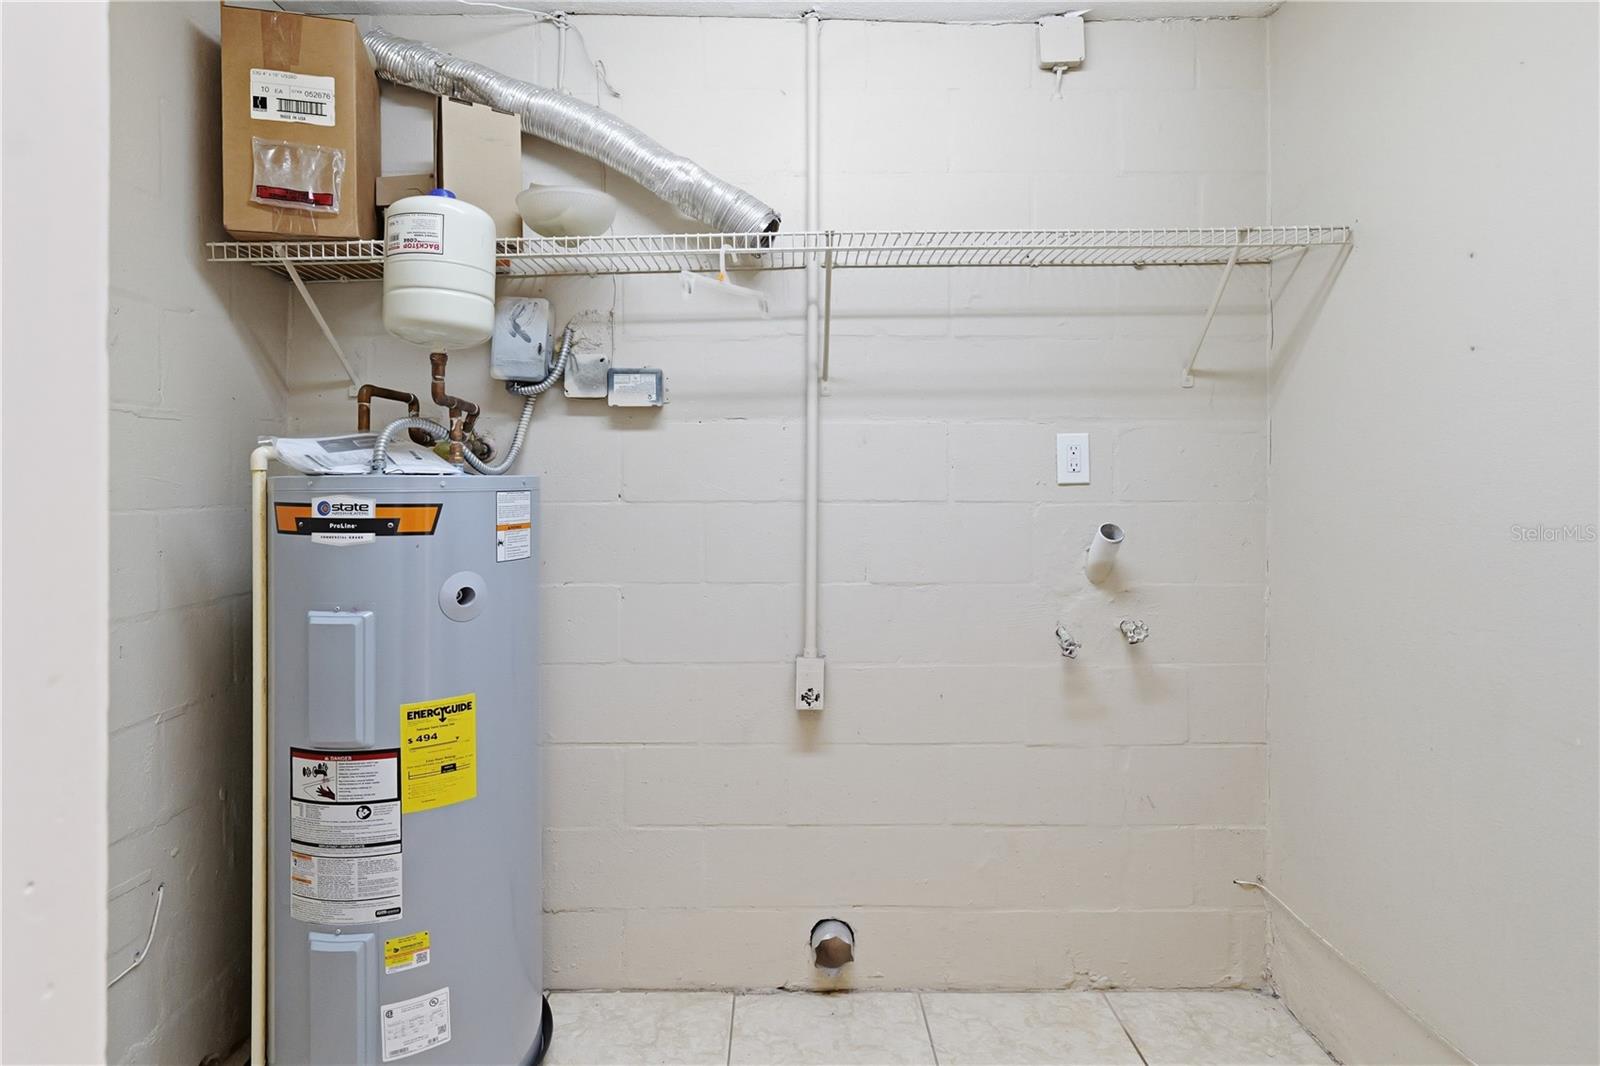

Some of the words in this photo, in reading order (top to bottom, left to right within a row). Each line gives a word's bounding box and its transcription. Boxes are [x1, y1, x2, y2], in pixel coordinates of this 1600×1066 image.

[403, 243, 440, 251] BACKSTOP
[331, 503, 369, 512] state
[416, 732, 438, 742] 494
